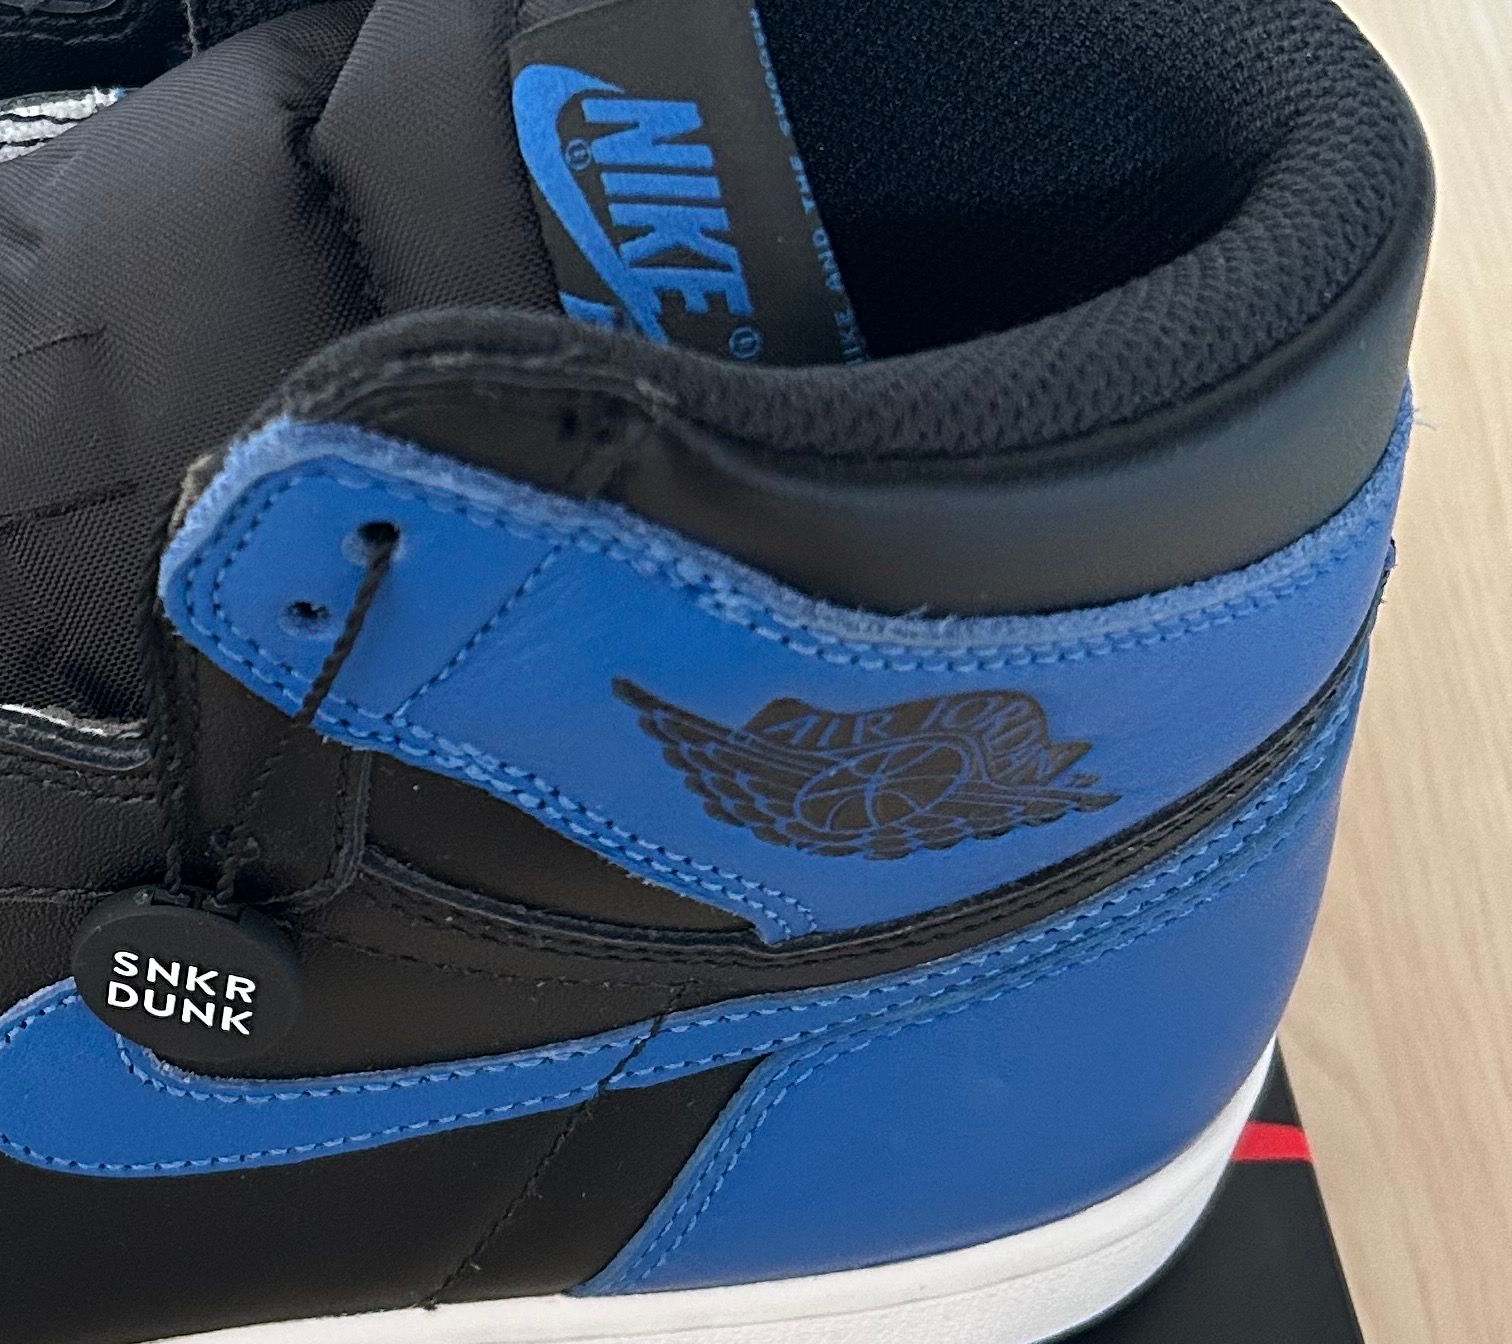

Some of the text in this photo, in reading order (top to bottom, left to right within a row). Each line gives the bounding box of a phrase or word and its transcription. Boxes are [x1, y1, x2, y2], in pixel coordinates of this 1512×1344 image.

[582, 97, 754, 317] NIKE
[762, 713, 896, 747] AIR
[113, 950, 256, 1004] SNKR
[107, 980, 253, 1036] DUNK
